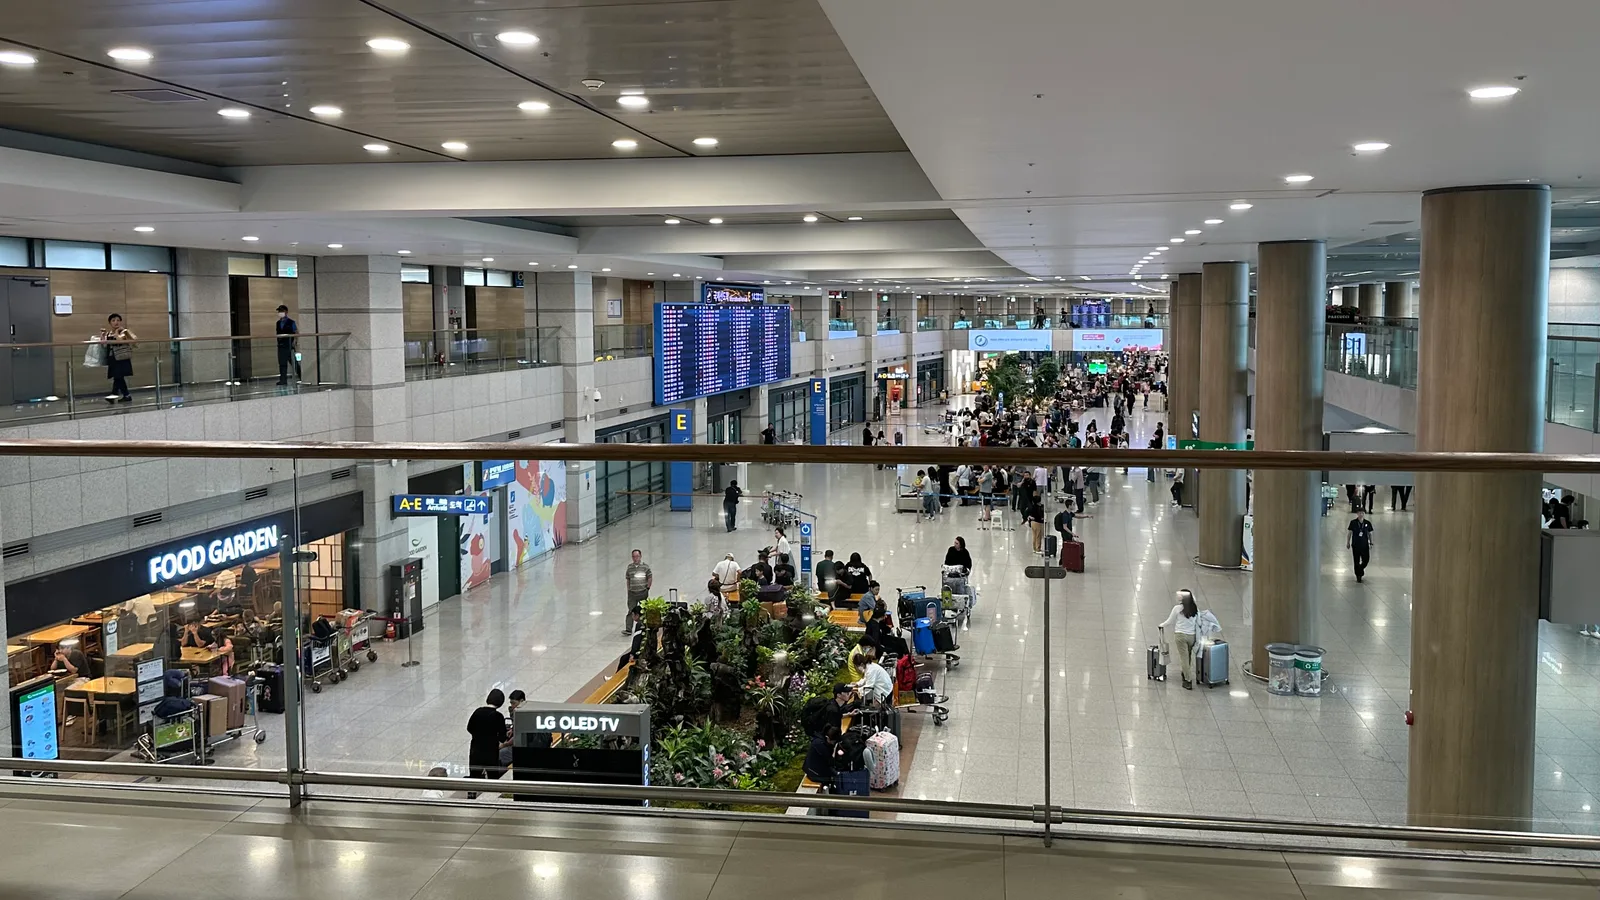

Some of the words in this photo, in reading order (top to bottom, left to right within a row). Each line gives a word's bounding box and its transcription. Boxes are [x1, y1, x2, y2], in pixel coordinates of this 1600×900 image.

[814, 381, 822, 393] E
[677, 414, 687, 430] E
[400, 498, 422, 511] A-E
[148, 545, 206, 584] FOOD
[208, 524, 279, 565] GARDEN
[536, 715, 556, 730] LG
[559, 715, 598, 731] OLED
[599, 717, 620, 732] TV
